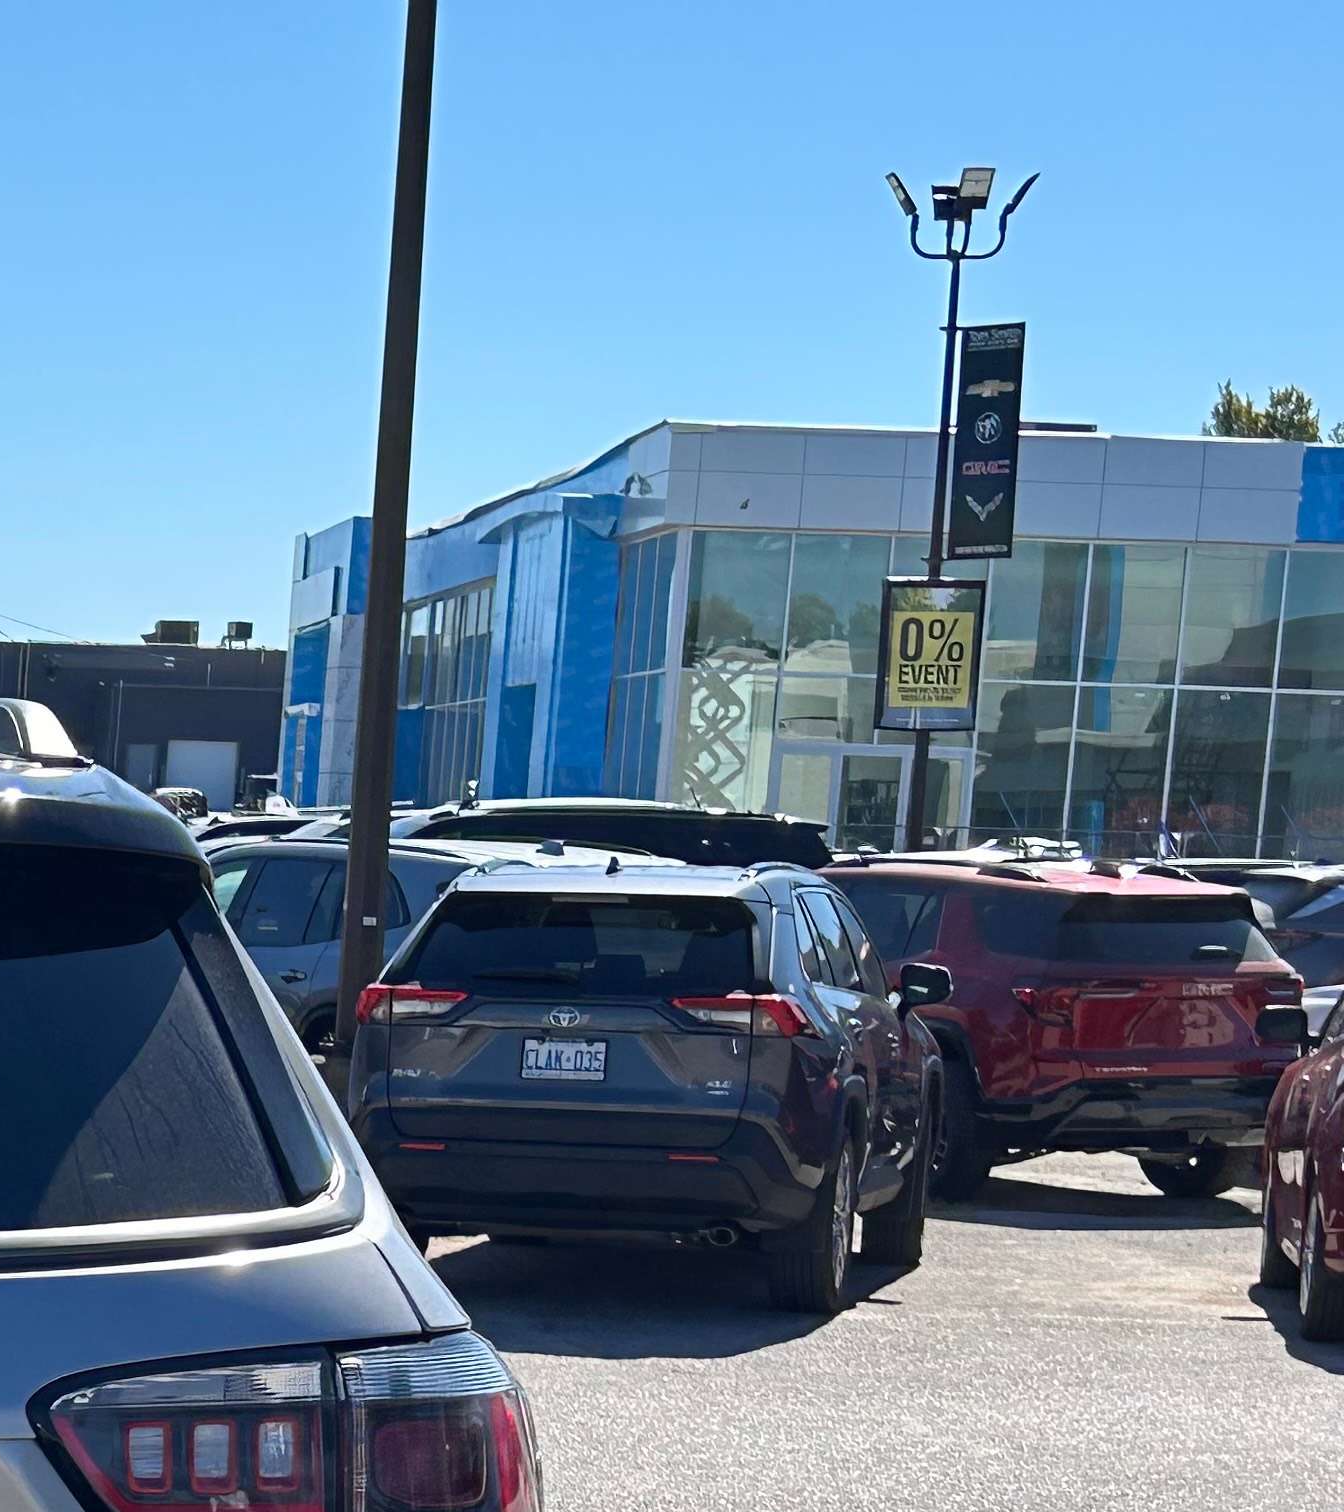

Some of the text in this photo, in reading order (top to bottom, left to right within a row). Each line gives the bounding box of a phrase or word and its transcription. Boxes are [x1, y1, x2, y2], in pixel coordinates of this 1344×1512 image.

[899, 617, 965, 663] 0%
[898, 663, 963, 686] EVENT
[574, 1049, 604, 1072] 035
